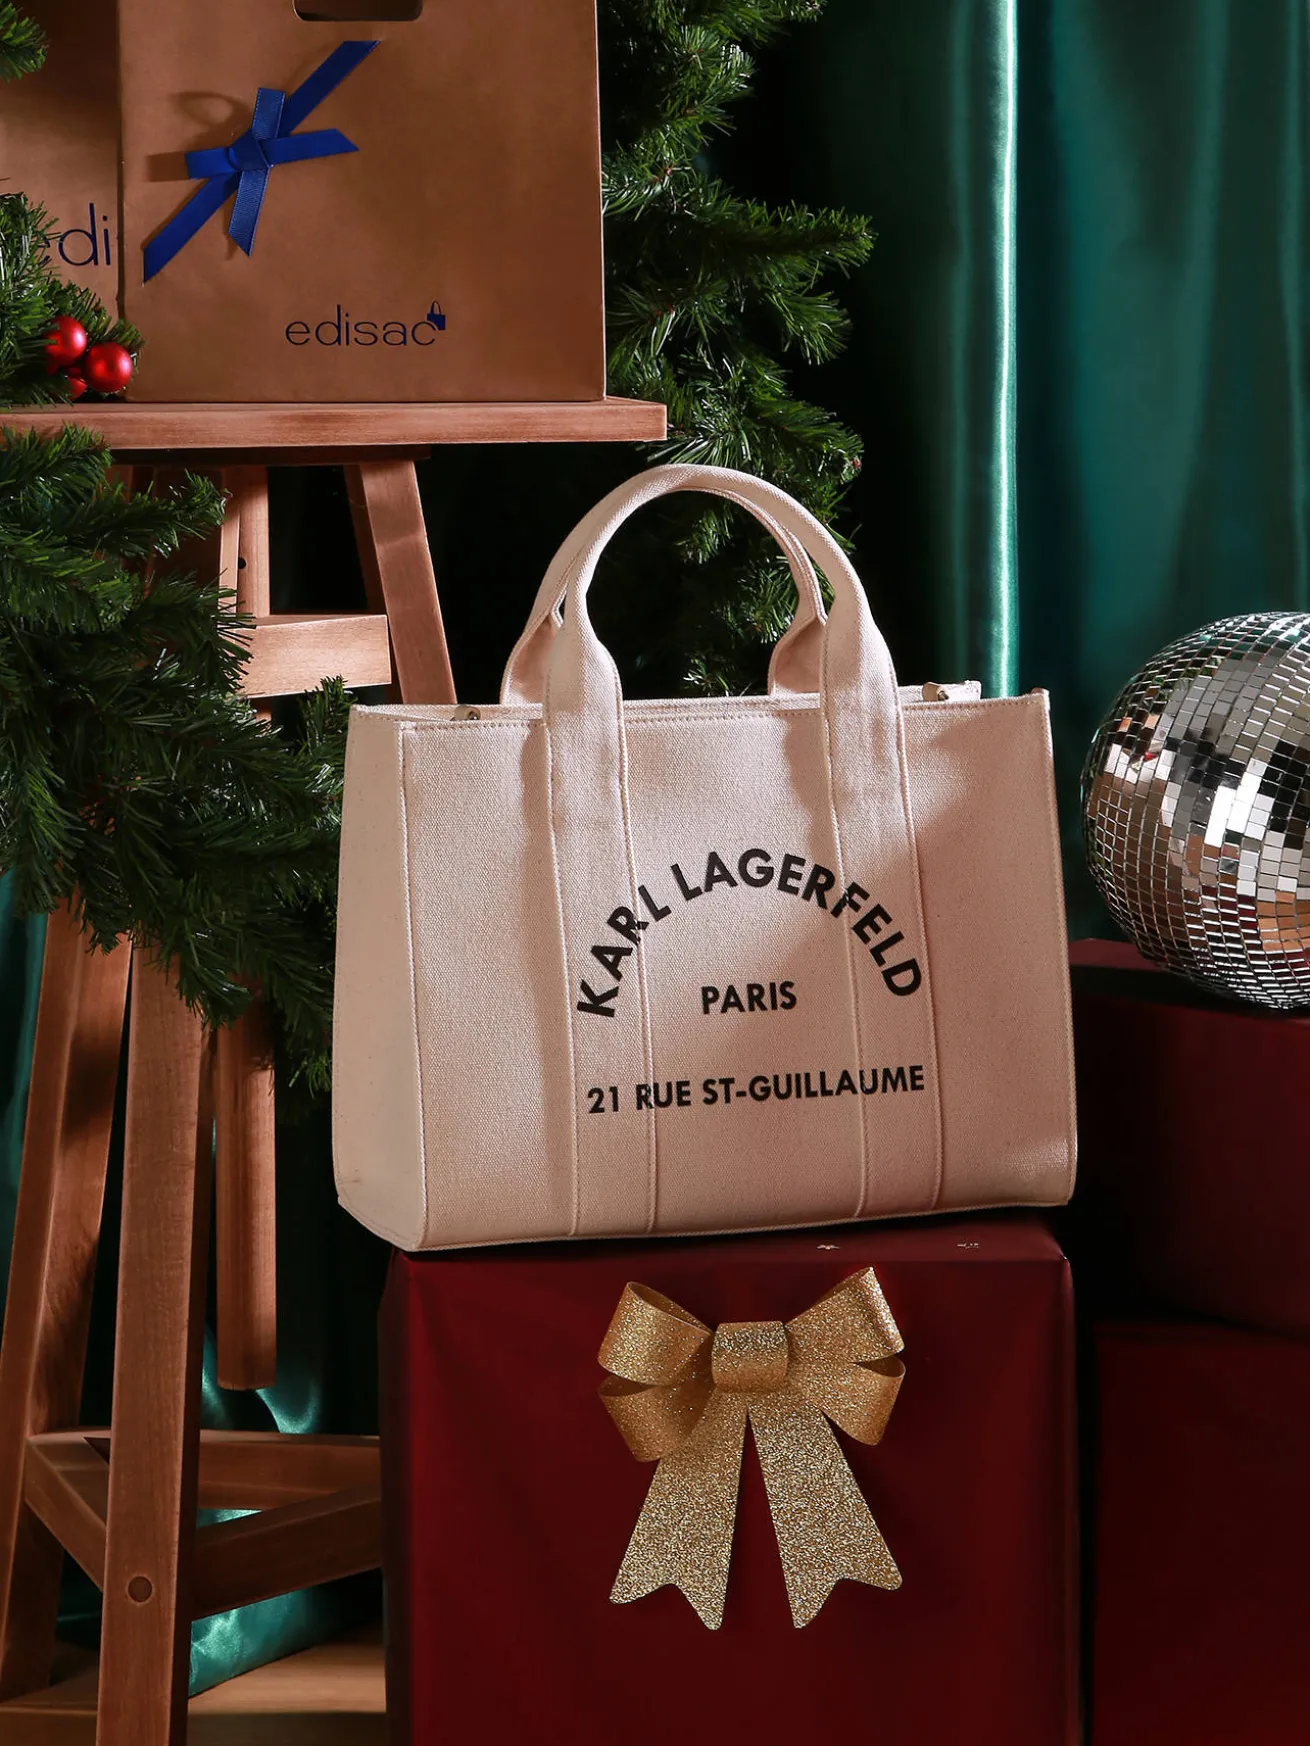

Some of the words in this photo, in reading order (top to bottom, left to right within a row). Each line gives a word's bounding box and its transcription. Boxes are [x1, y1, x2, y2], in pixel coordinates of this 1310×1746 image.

[285, 304, 437, 346] edisac
[576, 884, 672, 1018] KARL
[670, 848, 923, 996] LAGERFELD
[701, 980, 798, 1015] PARIS
[587, 1086, 619, 1114] 21
[635, 1080, 692, 1111] RUE
[702, 1065, 925, 1106] ST-GUILLAUME
